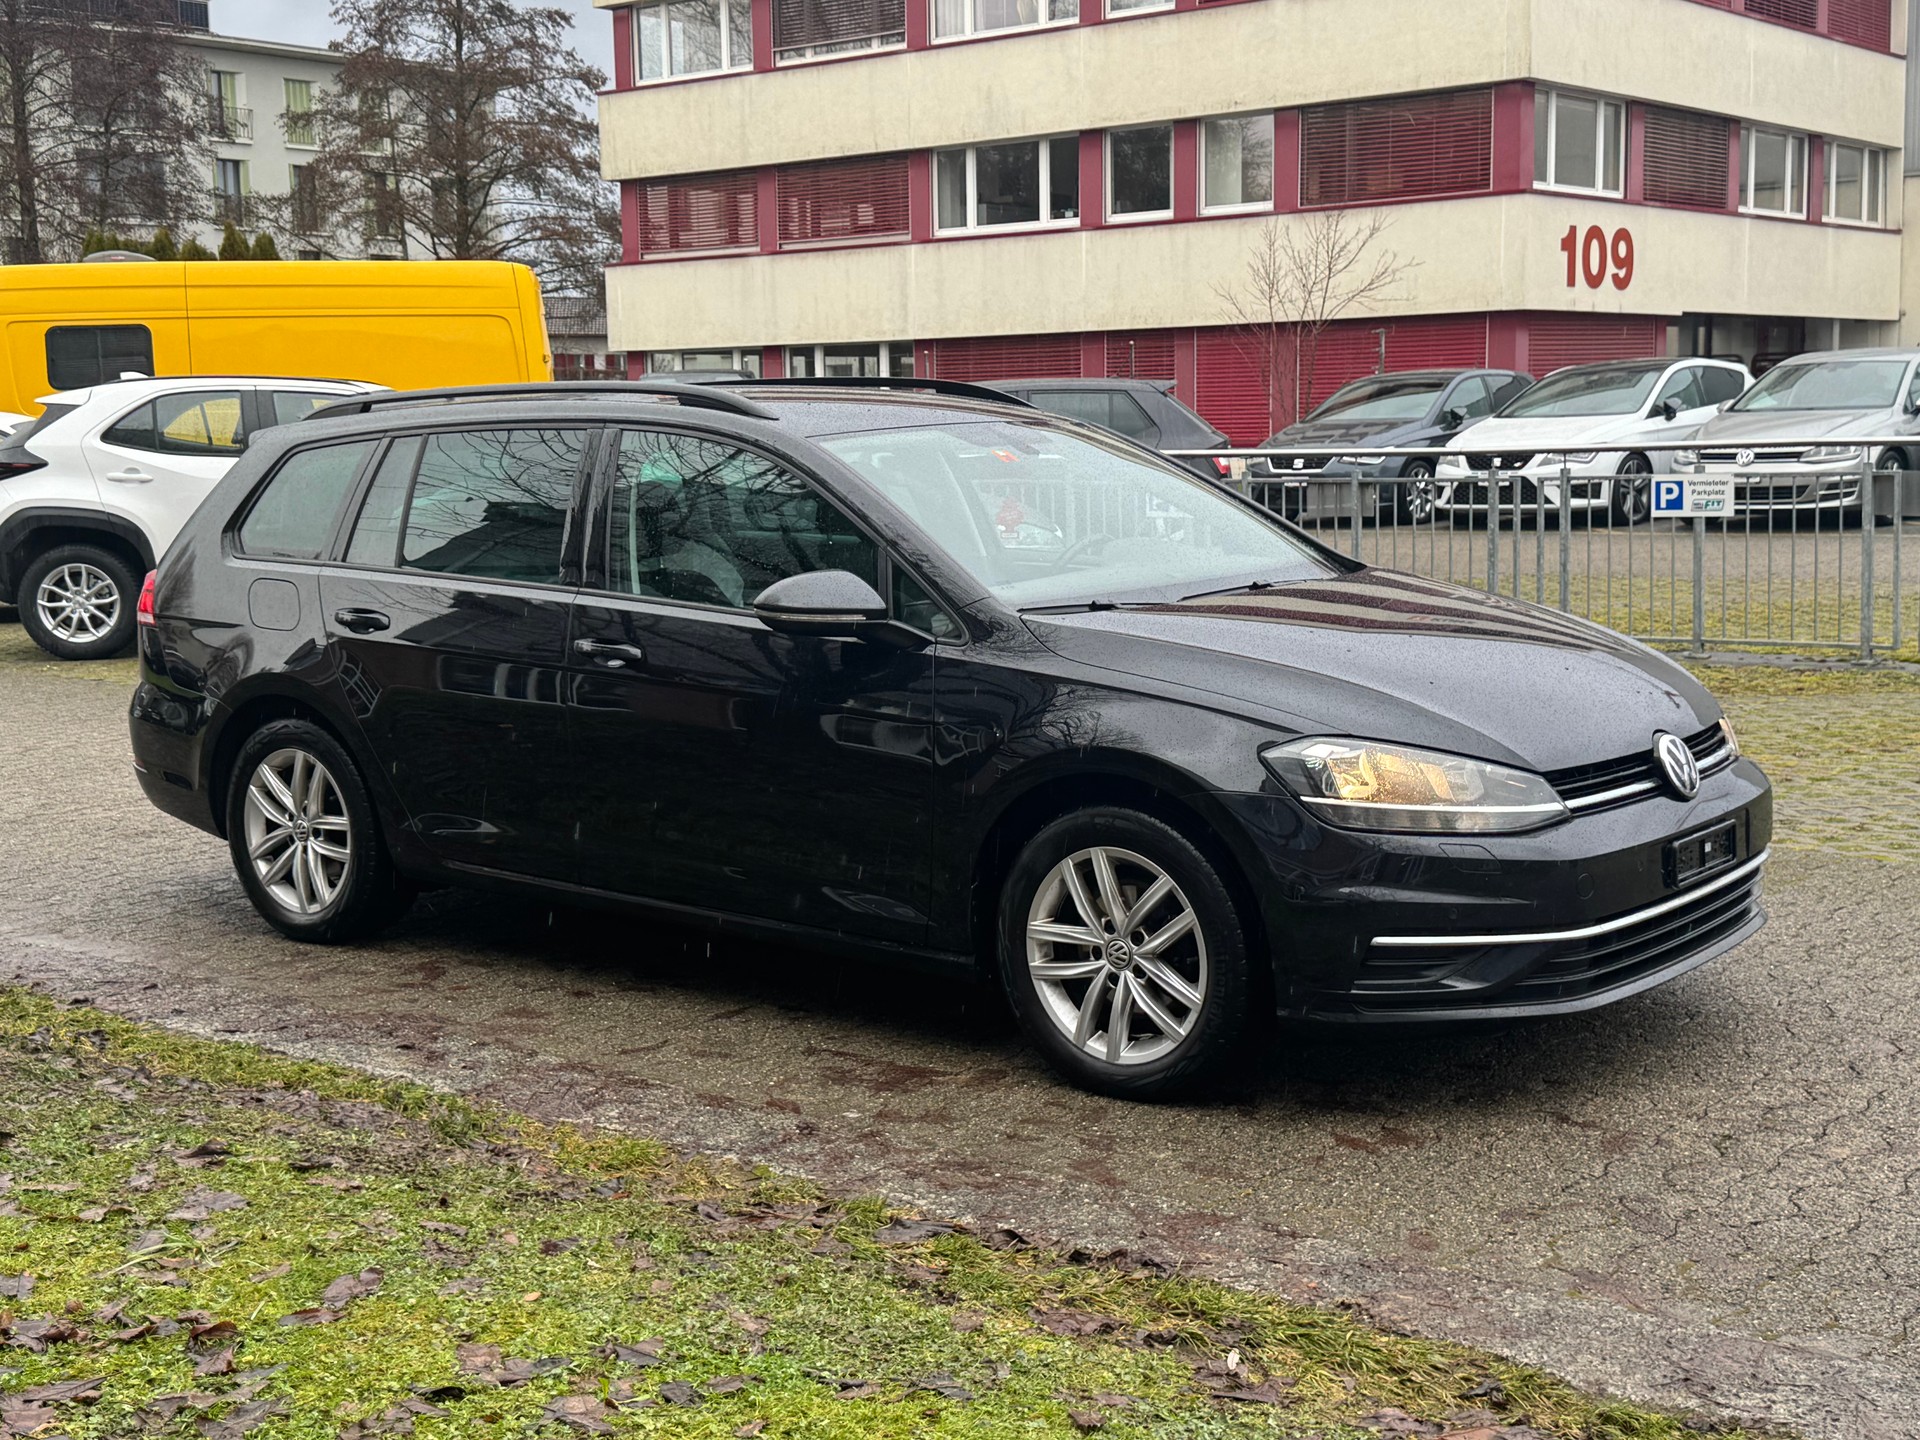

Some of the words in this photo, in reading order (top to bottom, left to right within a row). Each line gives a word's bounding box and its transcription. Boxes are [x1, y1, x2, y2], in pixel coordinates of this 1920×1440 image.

[1560, 224, 1634, 291] 109
[1660, 483, 1679, 508] P
[1704, 500, 1722, 509] FIT
